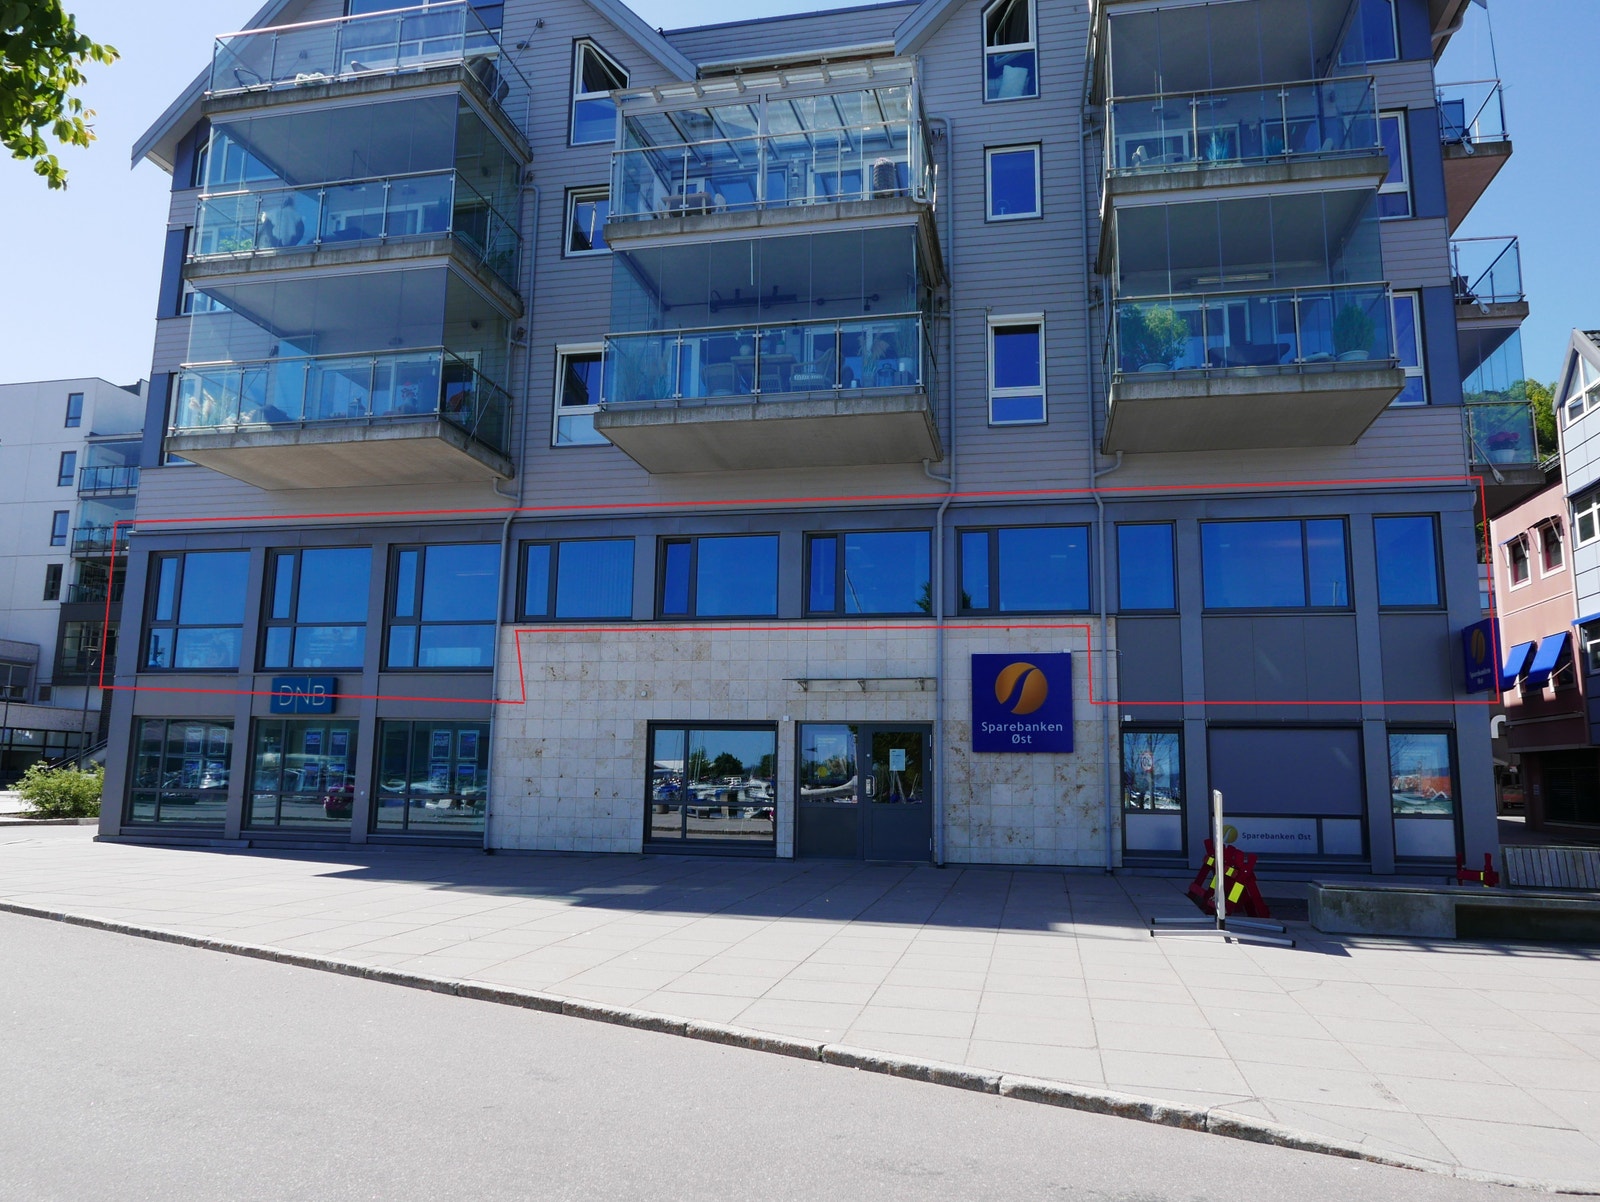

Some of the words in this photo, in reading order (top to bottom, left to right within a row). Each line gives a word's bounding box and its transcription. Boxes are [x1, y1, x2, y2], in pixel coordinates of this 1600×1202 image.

[280, 680, 326, 711] DNB
[981, 721, 1063, 734] Sparebanken
[1011, 734, 1032, 744] Øst
[1241, 832, 1295, 841] Sparebanken
[1297, 833, 1312, 841] Øst
